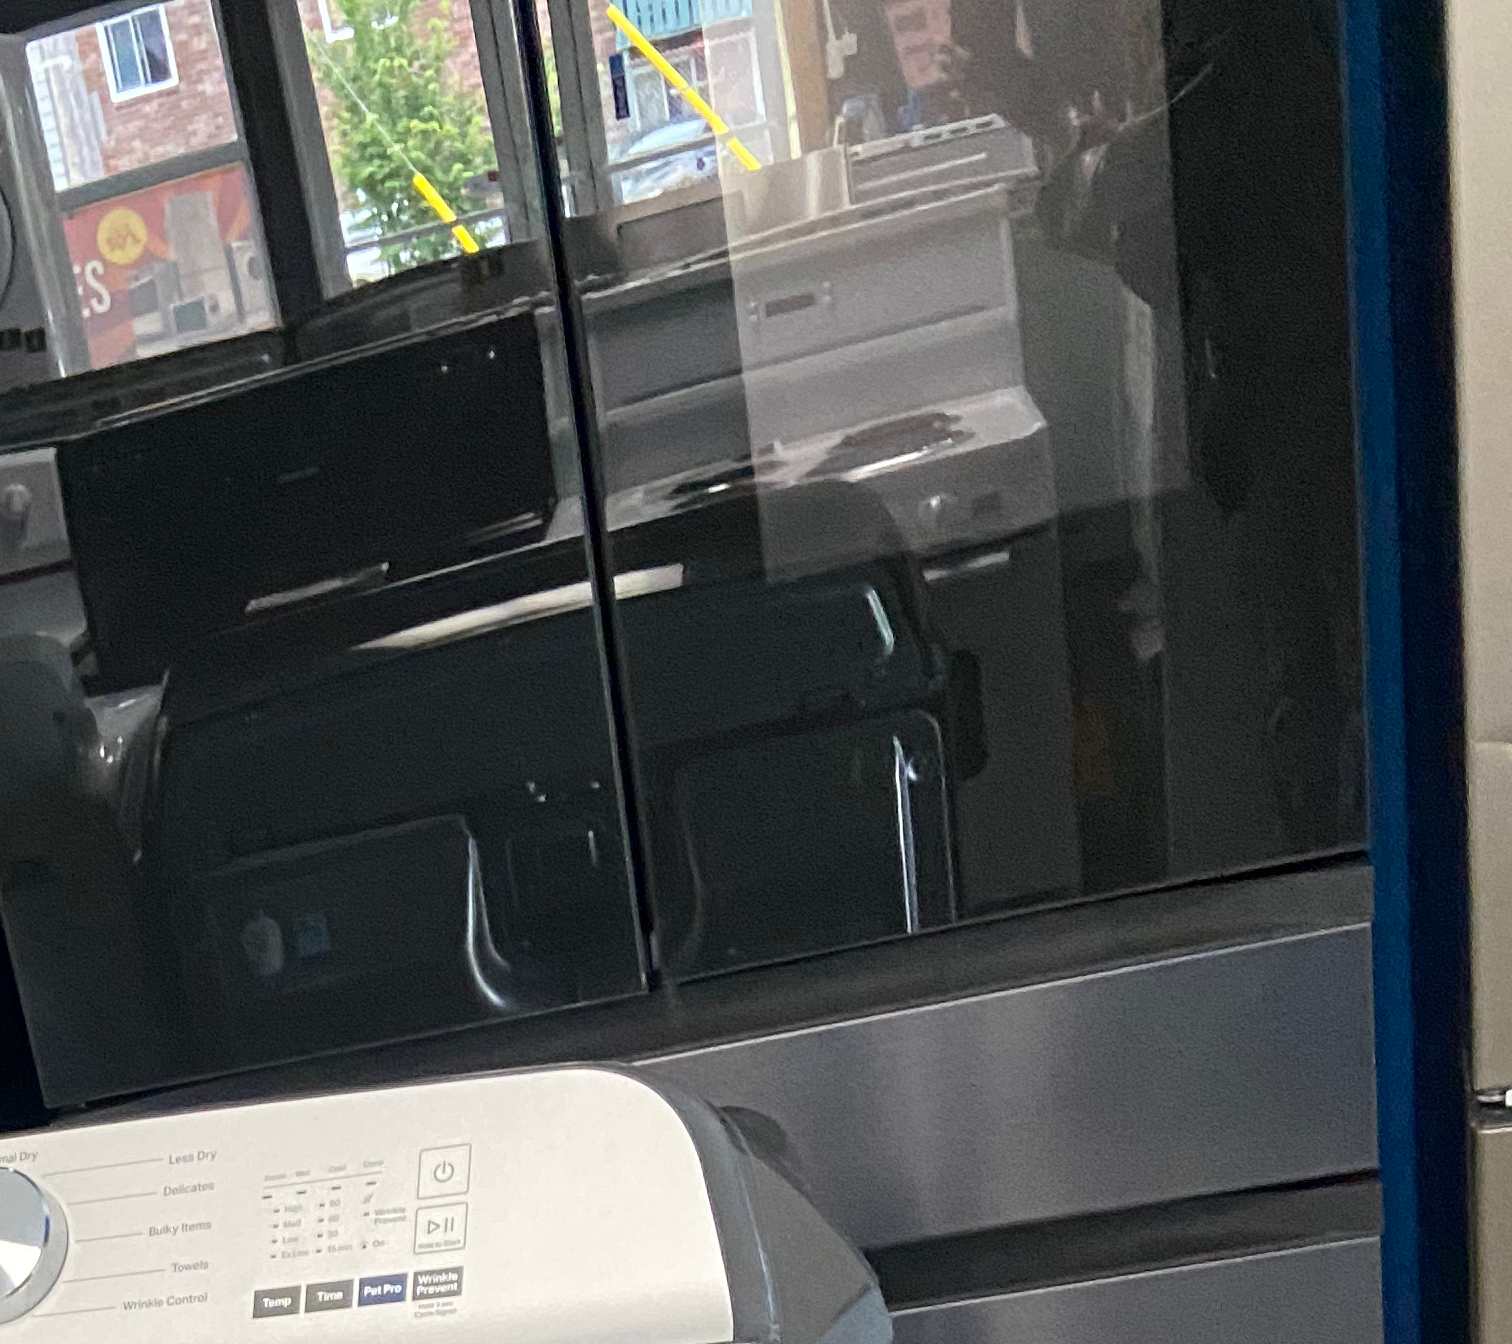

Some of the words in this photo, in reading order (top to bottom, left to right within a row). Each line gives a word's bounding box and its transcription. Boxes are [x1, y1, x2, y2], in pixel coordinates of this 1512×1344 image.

[19, 1150, 39, 1164] Dry
[168, 1153, 194, 1165] Less
[197, 1150, 217, 1162] Dry
[163, 1181, 215, 1197] Delicates
[149, 1223, 179, 1237] Bulky
[181, 1220, 212, 1233] Items
[172, 1259, 209, 1273] Towels
[417, 1271, 459, 1285] Wrinkle
[364, 1285, 381, 1297] Pet
[383, 1284, 402, 1295] Pro
[416, 1282, 458, 1296] Prevent
[123, 1298, 164, 1311] Wrinkle
[166, 1292, 208, 1307] Control
[263, 1297, 292, 1309] Temp
[317, 1291, 344, 1302] Time
